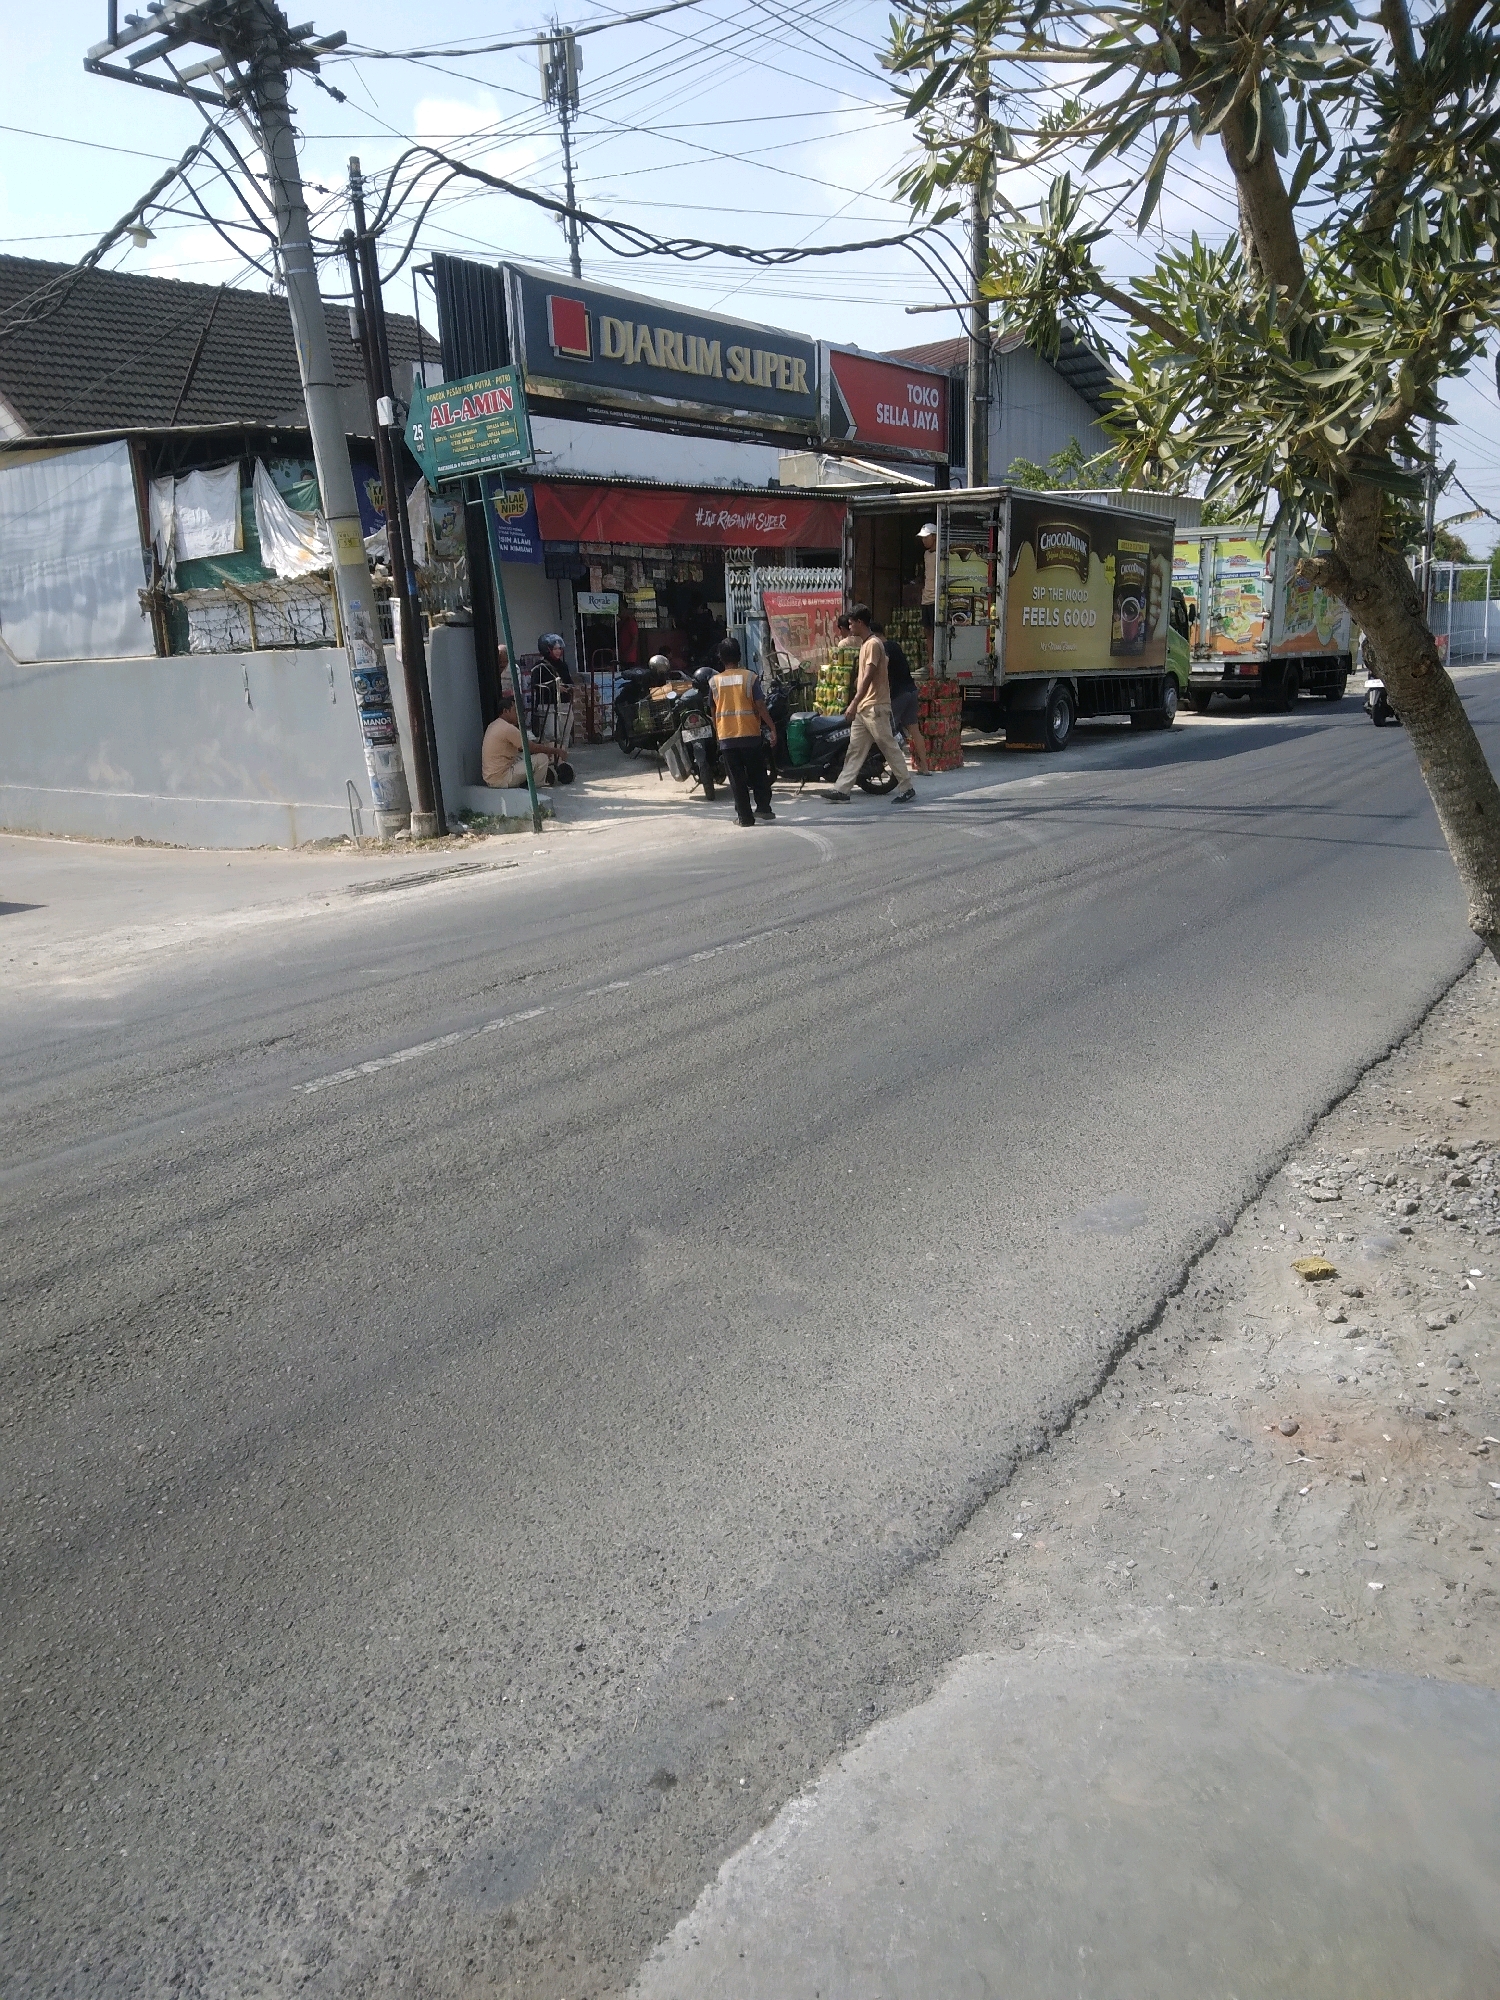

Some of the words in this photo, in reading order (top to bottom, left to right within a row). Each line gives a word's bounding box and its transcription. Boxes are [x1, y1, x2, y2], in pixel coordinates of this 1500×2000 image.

[600, 315, 723, 378] DJARUM
[726, 345, 810, 395] SUPER
[907, 384, 939, 408] TOKO
[430, 386, 514, 430] AL-AMIN
[876, 405, 909, 427] SELLA
[912, 411, 940, 433] JAYA
[412, 423, 424, 441] 25
[501, 503, 524, 513] NIPIS
[755, 512, 788, 533] SUPER
[1032, 586, 1045, 600] SIP
[1048, 587, 1063, 601] THE
[1065, 590, 1089, 602] MOOD
[1022, 606, 1060, 627] FEELS
[1063, 608, 1097, 627] GOOD
